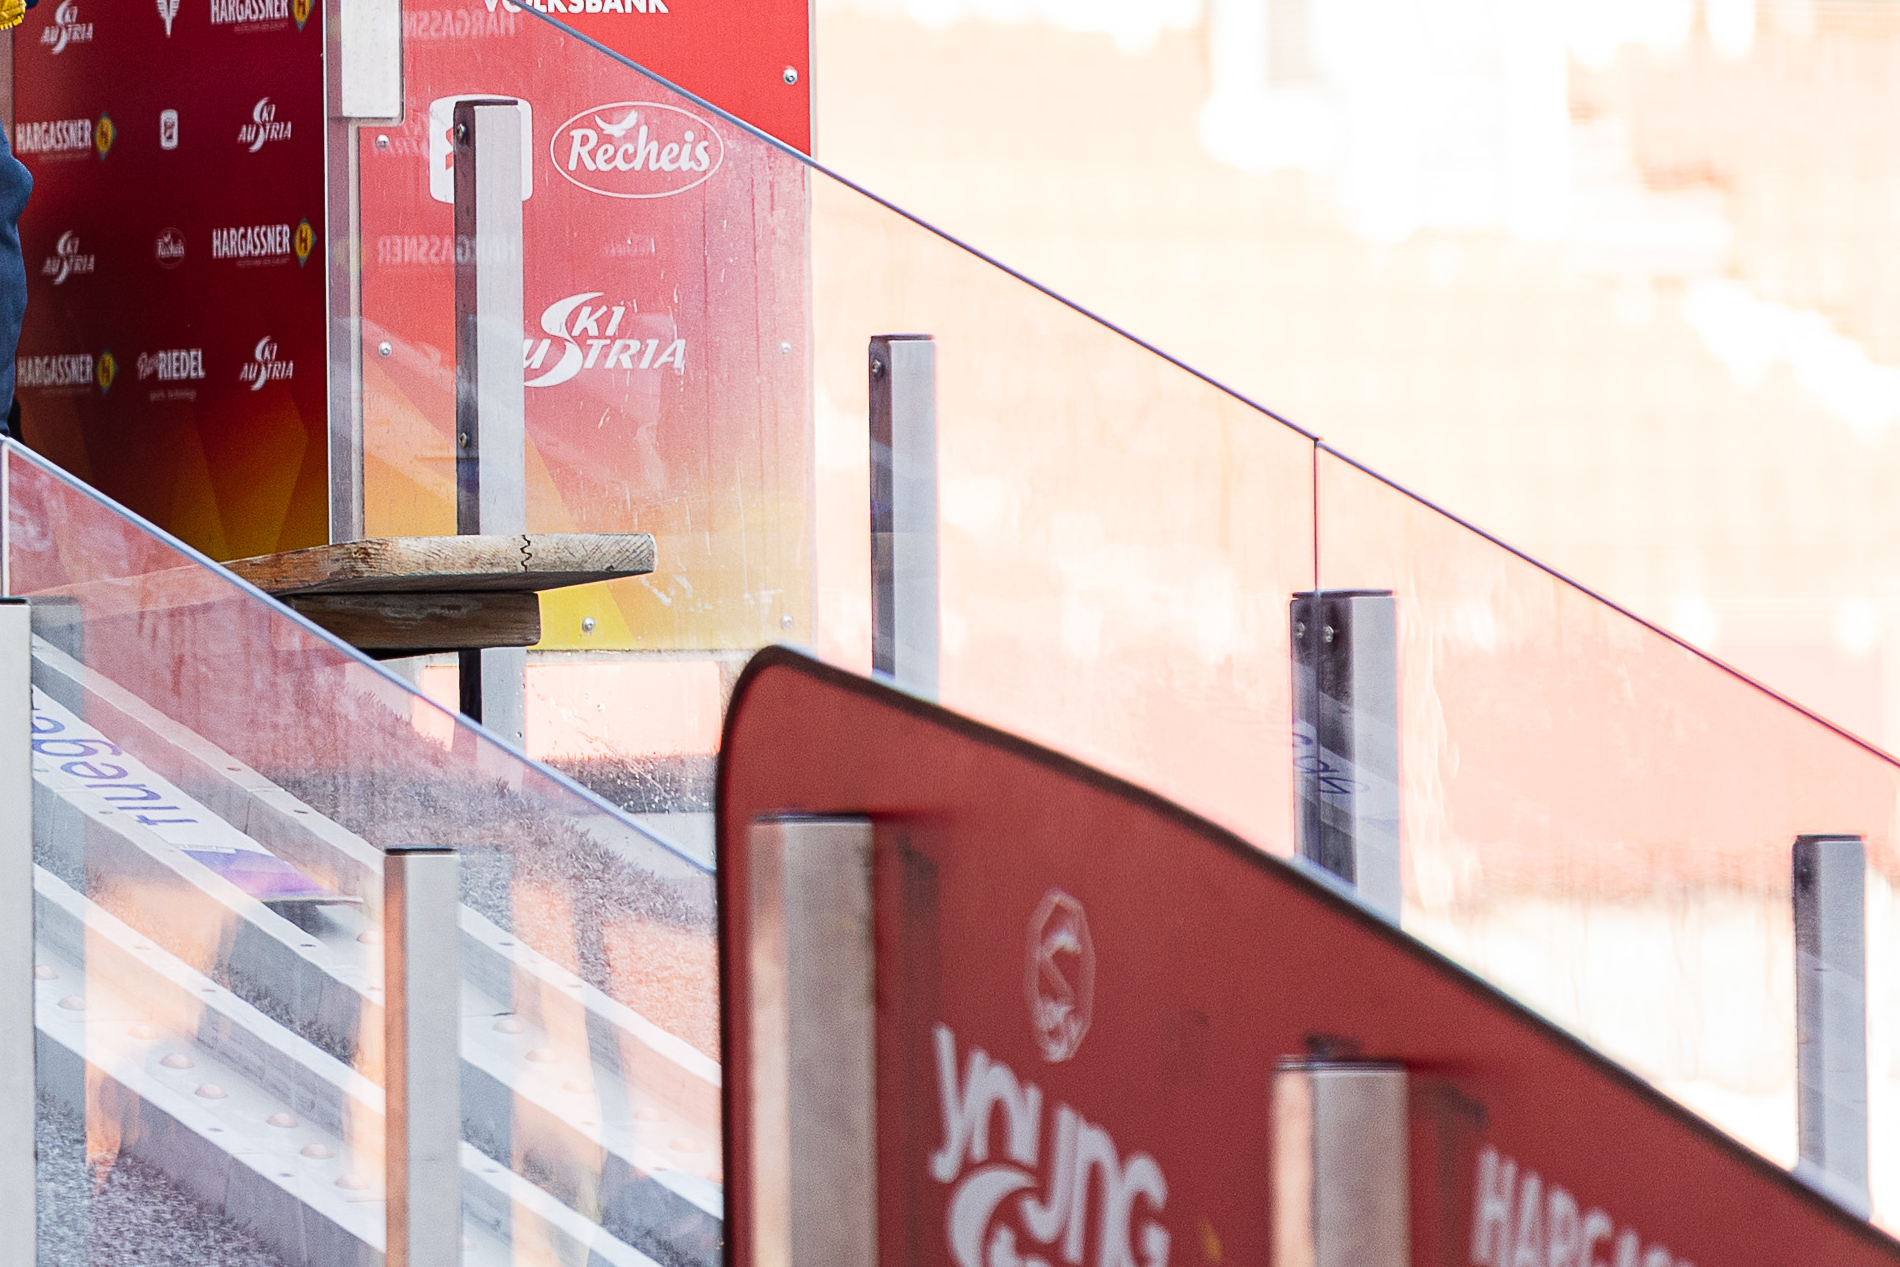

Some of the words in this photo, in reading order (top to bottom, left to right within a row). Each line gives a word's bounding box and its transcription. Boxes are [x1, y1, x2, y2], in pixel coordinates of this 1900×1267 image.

[568, 125, 711, 172] Recheis
[212, 224, 290, 259] HARGASSNER
[541, 292, 626, 336] SKI
[157, 348, 205, 381] RIEDEL
[523, 337, 687, 388] USTRIA
